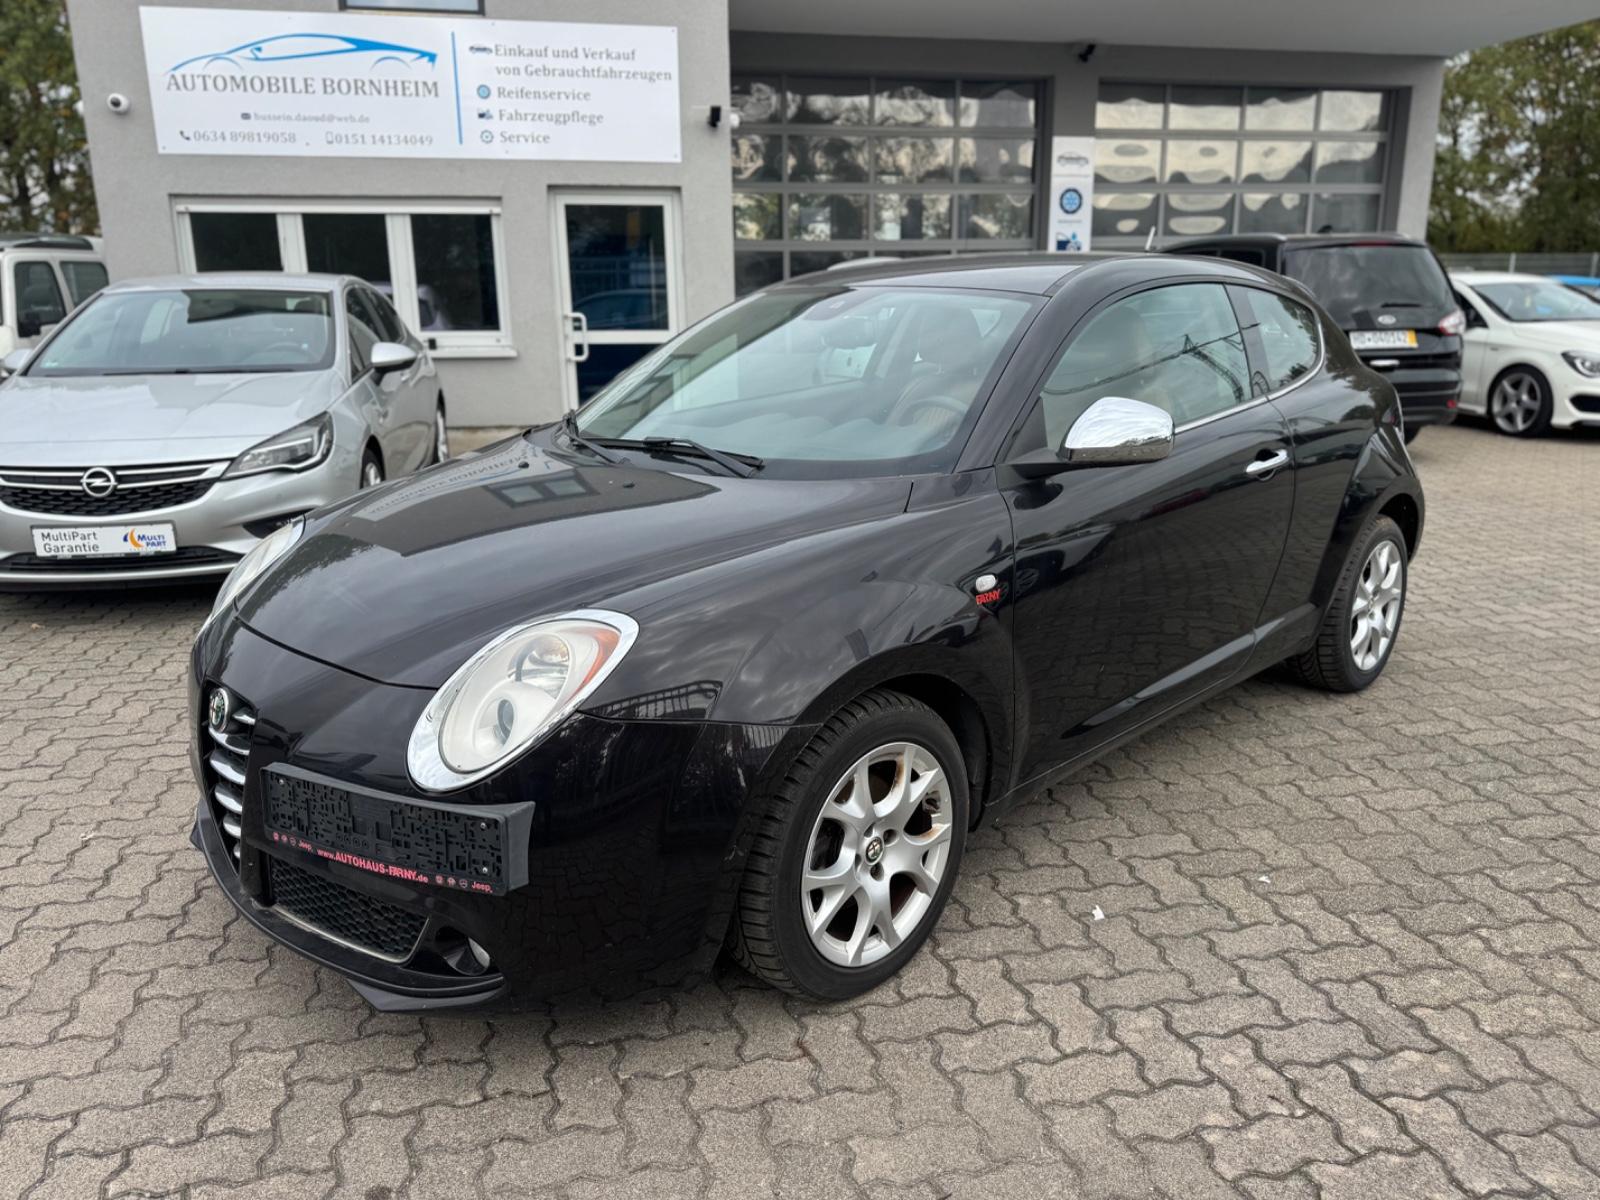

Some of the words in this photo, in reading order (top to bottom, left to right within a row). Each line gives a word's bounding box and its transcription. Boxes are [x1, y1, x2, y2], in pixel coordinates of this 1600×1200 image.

[494, 44, 548, 58] Einkauf
[552, 47, 579, 59] und
[582, 47, 636, 62] Verkauf
[495, 65, 521, 77] von
[524, 64, 673, 83] Gebrauchtfahrzeugen
[166, 73, 316, 96] AUTOMOBILE
[322, 77, 440, 99] BORNHEIM
[496, 87, 591, 102] Reifenservice
[498, 109, 604, 127] Fahrzeugpflege
[193, 129, 227, 143] 0634
[230, 131, 297, 145] 89819058
[334, 133, 366, 146] 0151
[499, 131, 551, 144] Service
[41, 531, 99, 542] MultiPart
[43, 542, 100, 553] Garantie
